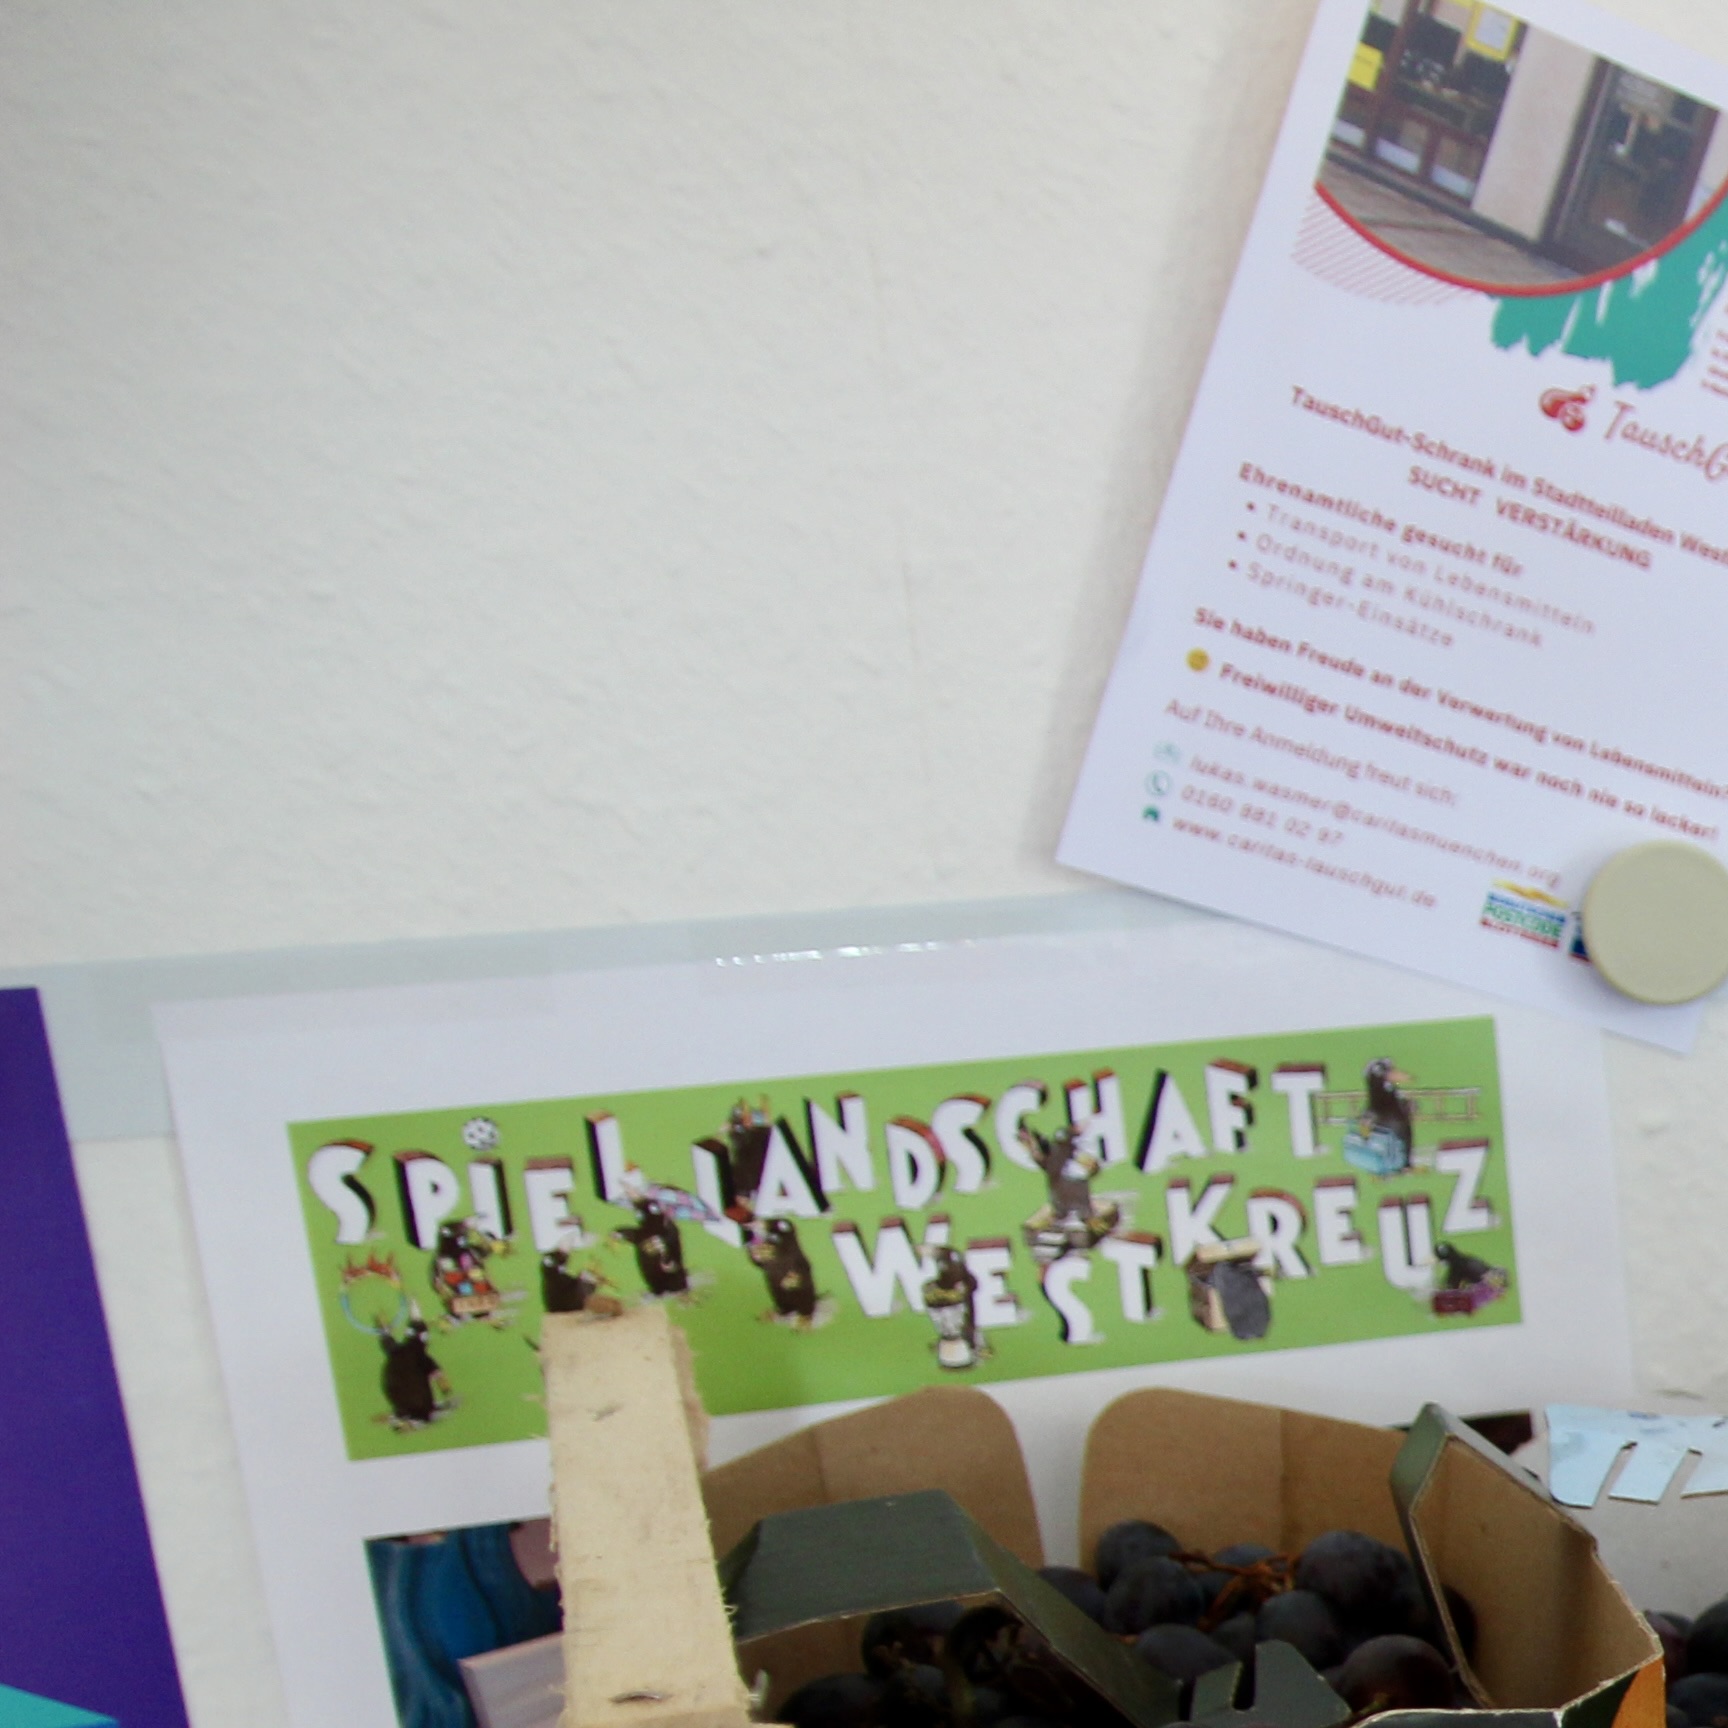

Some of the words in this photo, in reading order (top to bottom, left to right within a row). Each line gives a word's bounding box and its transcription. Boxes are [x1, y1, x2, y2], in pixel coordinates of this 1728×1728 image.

[1292, 385, 1497, 480] TauschGut-Schrank
[1500, 464, 1528, 490] im
[1239, 462, 1397, 532] Ehrenamtliche
[1401, 524, 1486, 564] gesucht
[1492, 552, 1523, 577] für
[1268, 503, 1380, 557] Transport
[1387, 550, 1427, 574] von
[1407, 465, 1482, 507] SUCHT
[1497, 496, 1652, 569] VERSTÄRKUNG
[1248, 562, 1454, 646] Springer-Einsätze
[1256, 533, 1355, 585] Ordnung
[1363, 573, 1395, 594] am
[1404, 586, 1542, 646] Kühlschrank
[1195, 607, 1226, 632] Sie
[1230, 619, 1292, 652] haben
[1297, 641, 1365, 677] Freude
[1399, 677, 1431, 699] der
[1219, 662, 1338, 715] Freiwilliger
[1165, 699, 1200, 723] Auf
[1251, 725, 1362, 780] Anmeldung
